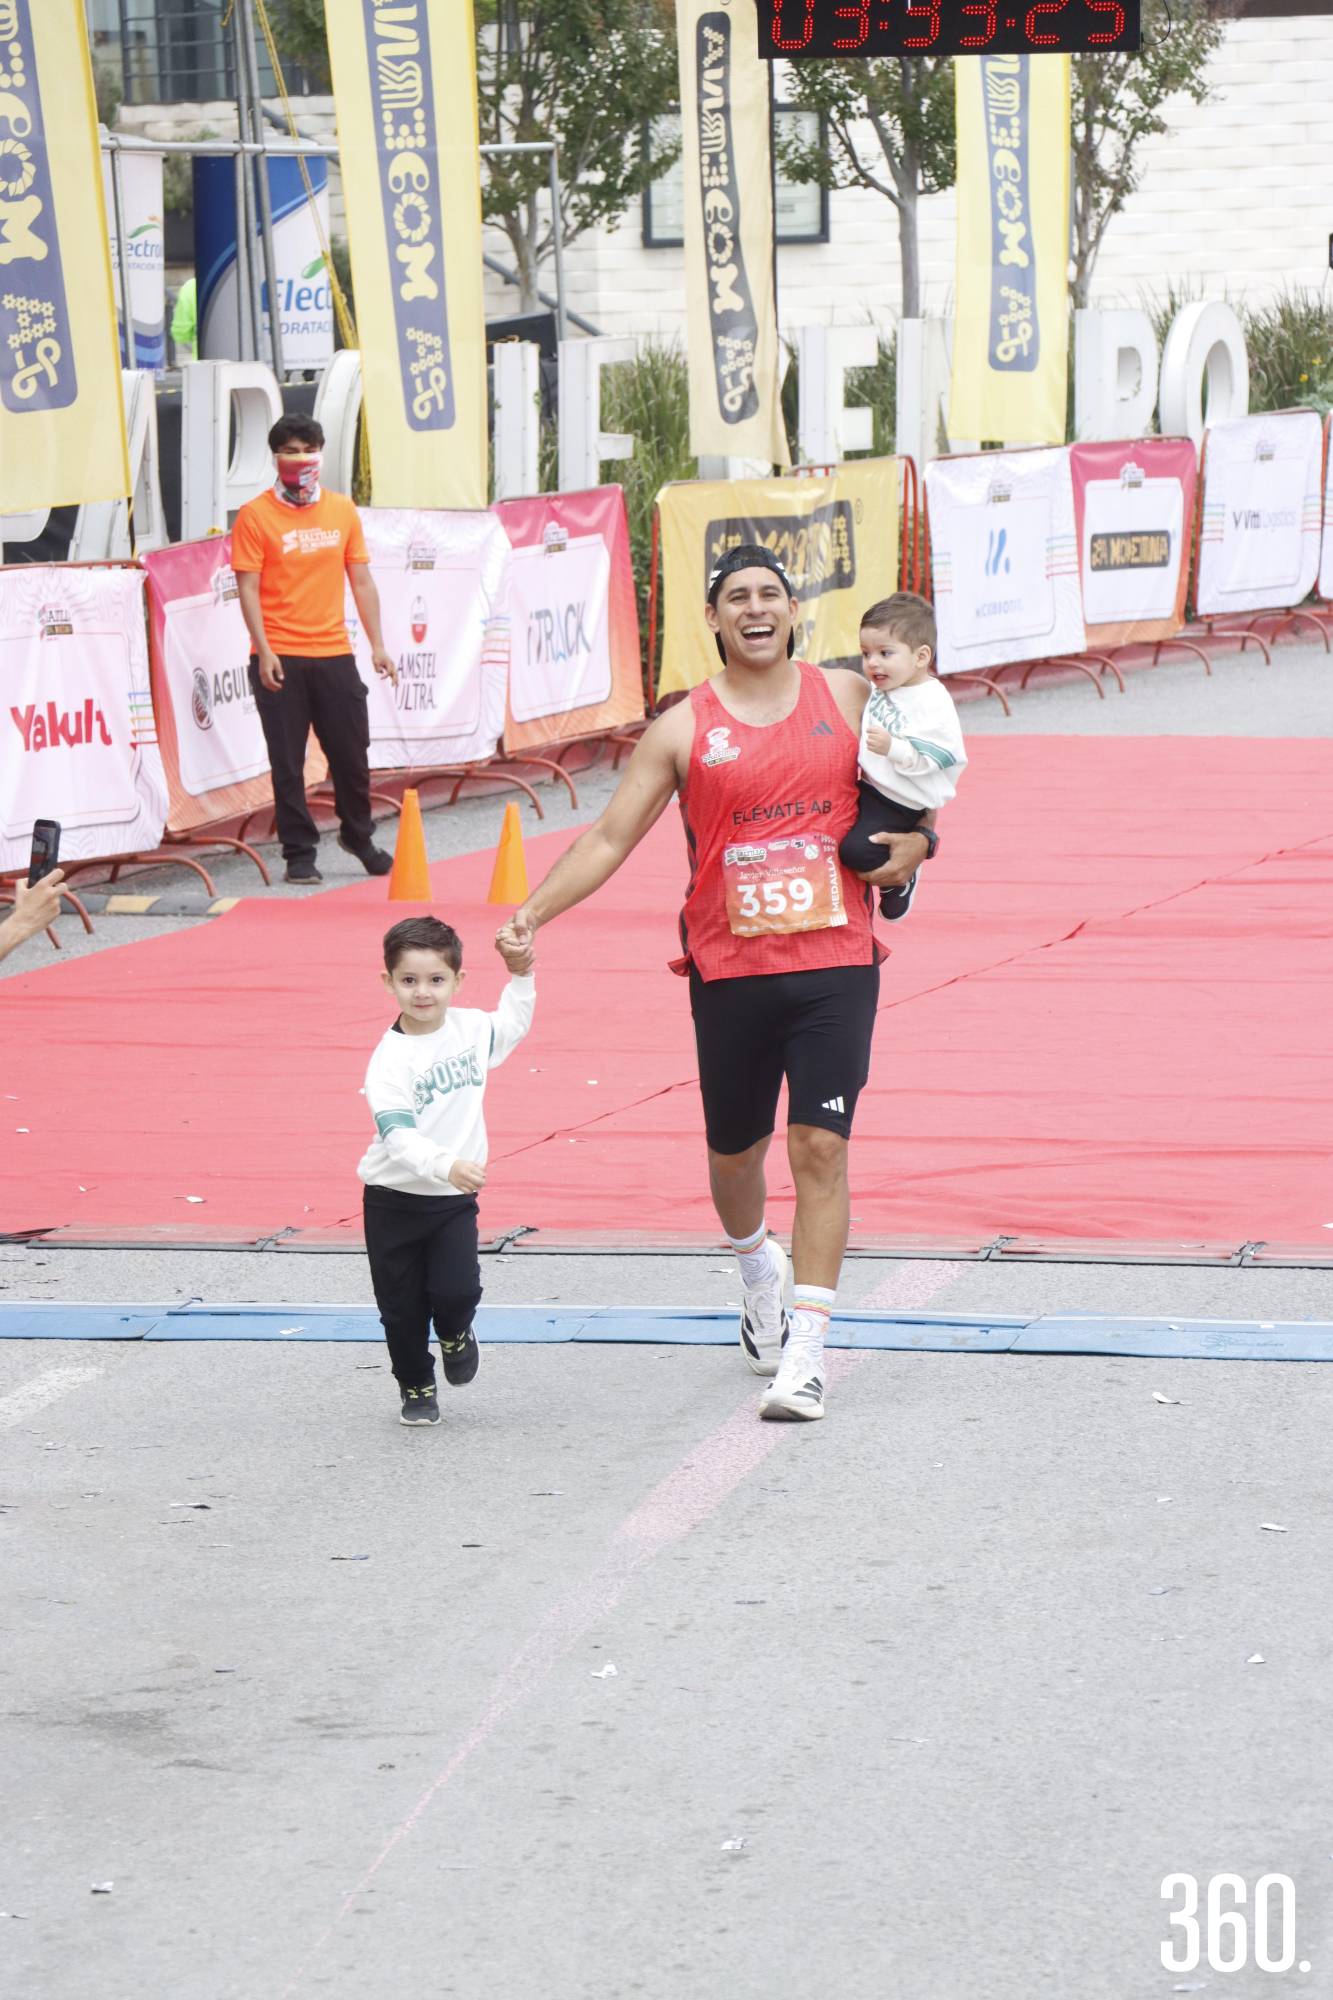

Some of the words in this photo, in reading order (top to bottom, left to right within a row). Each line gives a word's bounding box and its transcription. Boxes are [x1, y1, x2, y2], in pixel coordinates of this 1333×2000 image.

[398, 653, 436, 679] AMSTEL
[10, 698, 112, 752] Yakult
[810, 799, 832, 815] AB
[736, 877, 815, 918] 359
[825, 855, 842, 912] MEDALLA
